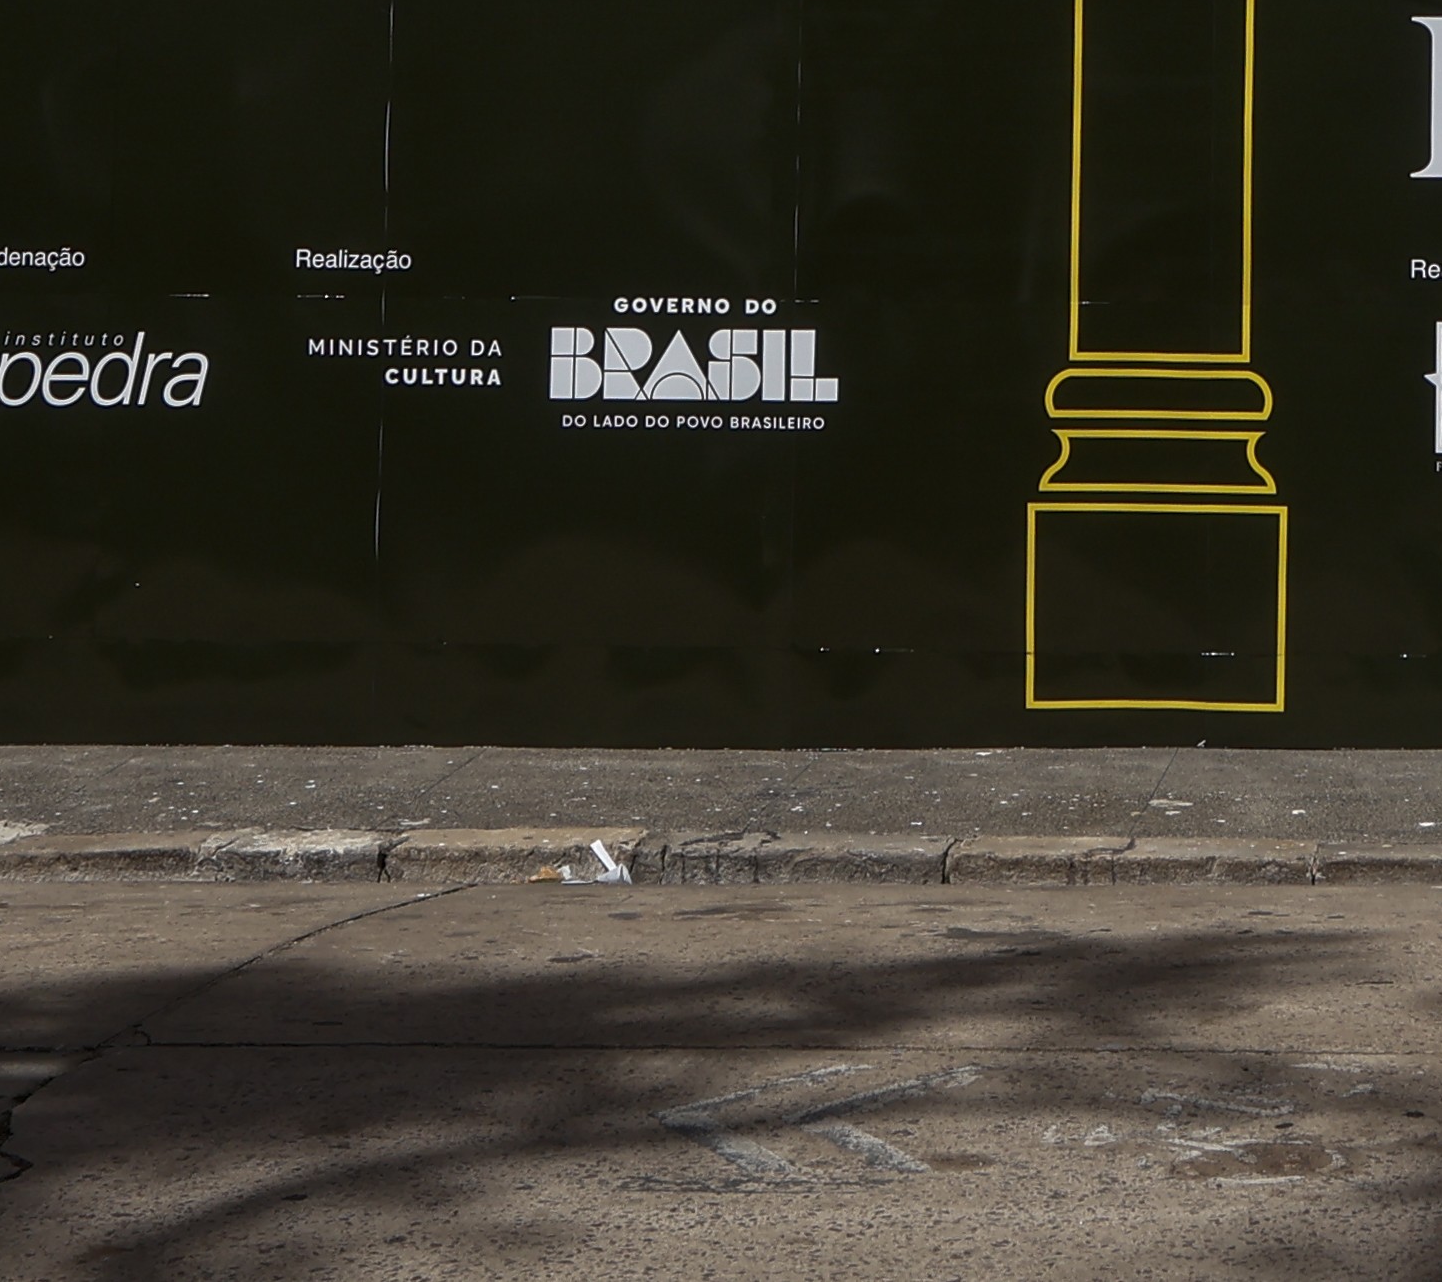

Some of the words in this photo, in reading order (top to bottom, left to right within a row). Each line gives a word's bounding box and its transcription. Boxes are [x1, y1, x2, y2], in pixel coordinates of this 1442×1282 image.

[295, 248, 412, 275] Realização
[613, 297, 730, 314] GOVERNO
[745, 298, 777, 315] DO
[4, 330, 124, 347] instituto
[308, 334, 458, 357] MINISTÉRIO
[470, 339, 502, 357] DA
[550, 327, 838, 401] BRASIL
[384, 368, 501, 386] CULTURA
[562, 414, 587, 428] DO
[593, 414, 639, 428] LADO
[645, 415, 670, 428] DO
[676, 415, 723, 429] POVO
[730, 416, 825, 430] BRASILEIRO
